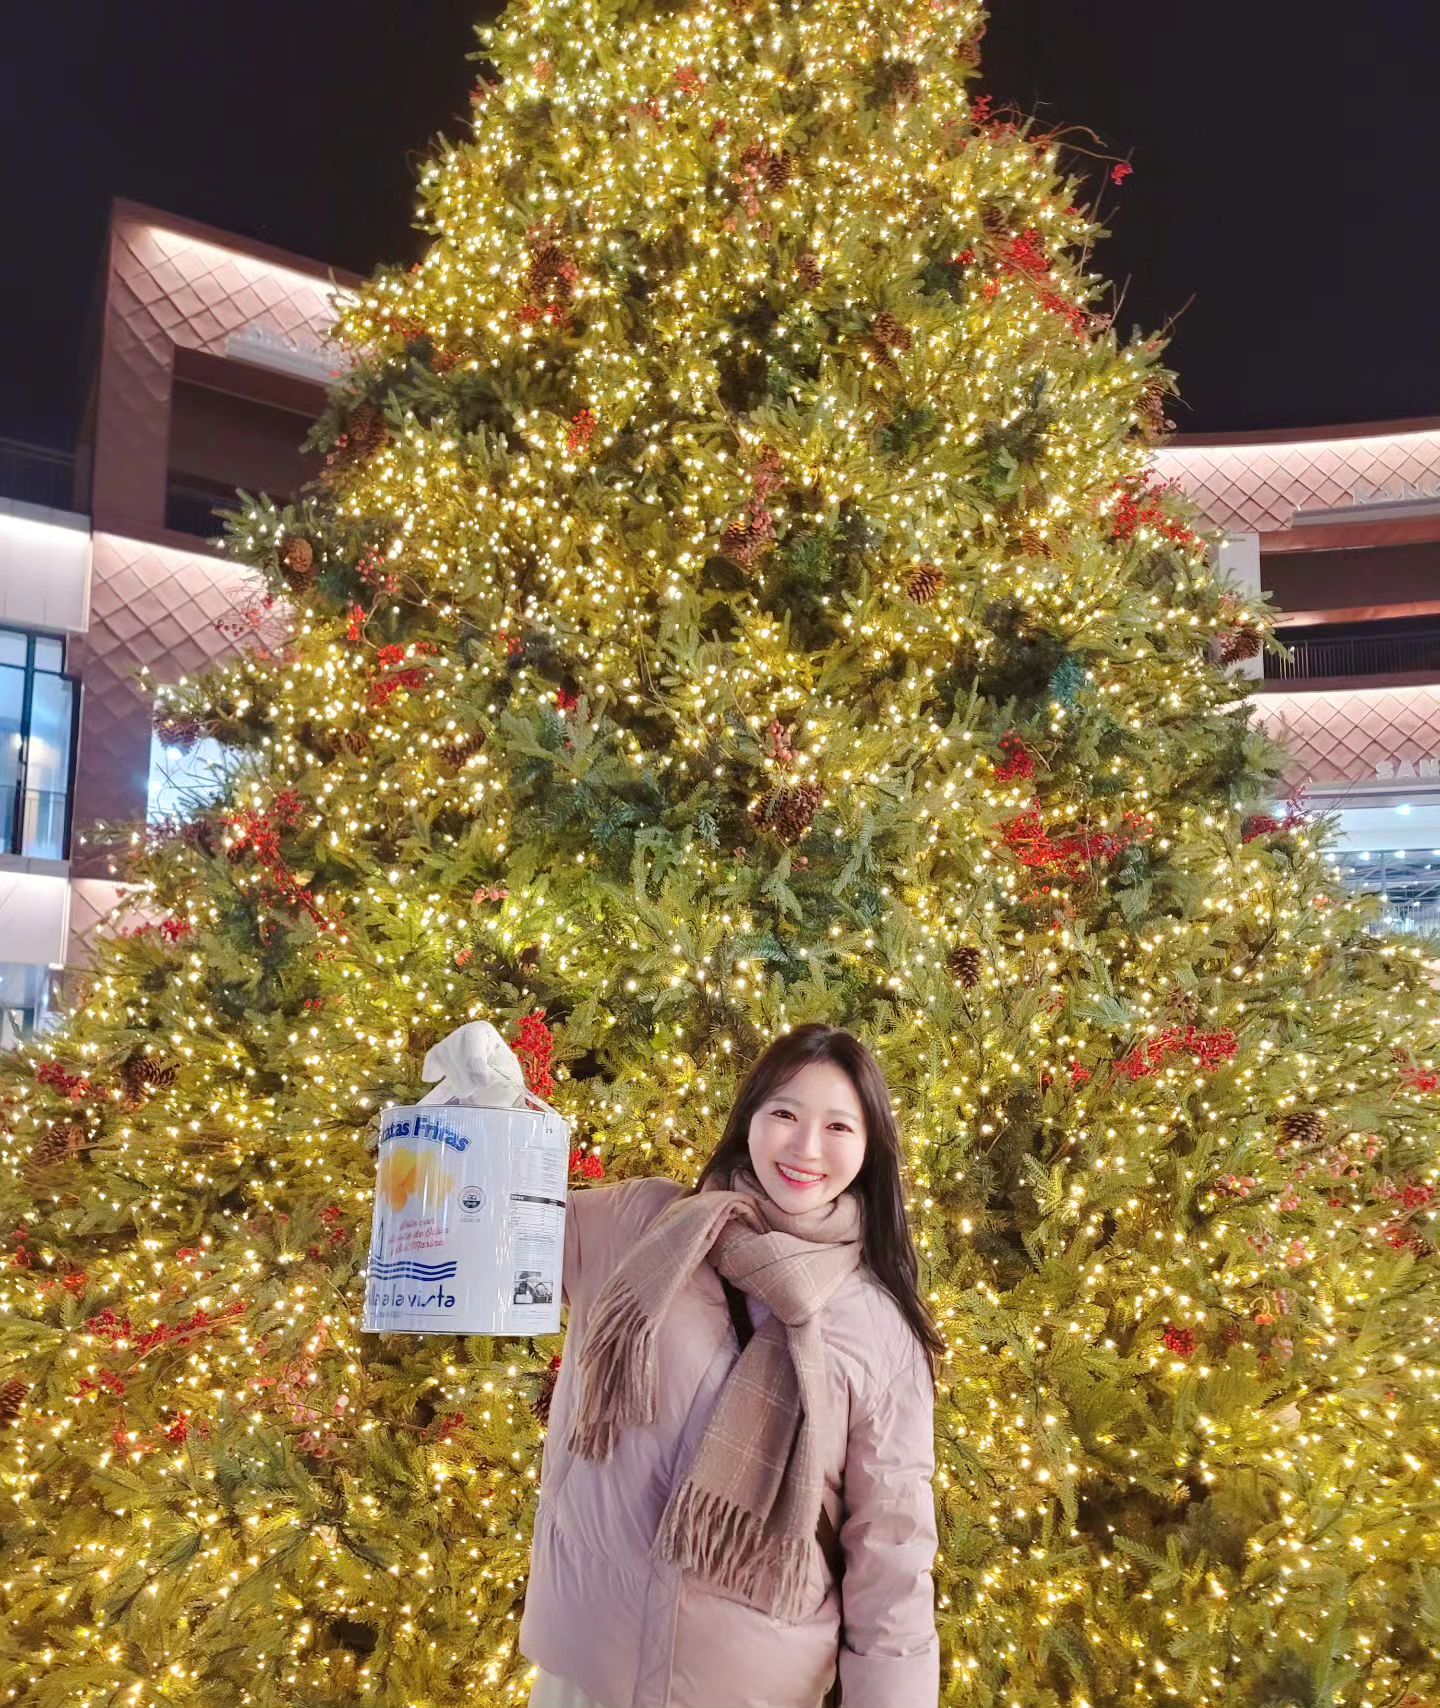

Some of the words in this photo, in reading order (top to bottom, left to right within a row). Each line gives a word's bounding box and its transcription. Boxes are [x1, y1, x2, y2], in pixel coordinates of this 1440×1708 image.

[382, 1120, 411, 1143] atas
[413, 1114, 471, 1153] Fritas
[407, 1284, 456, 1308] vista
